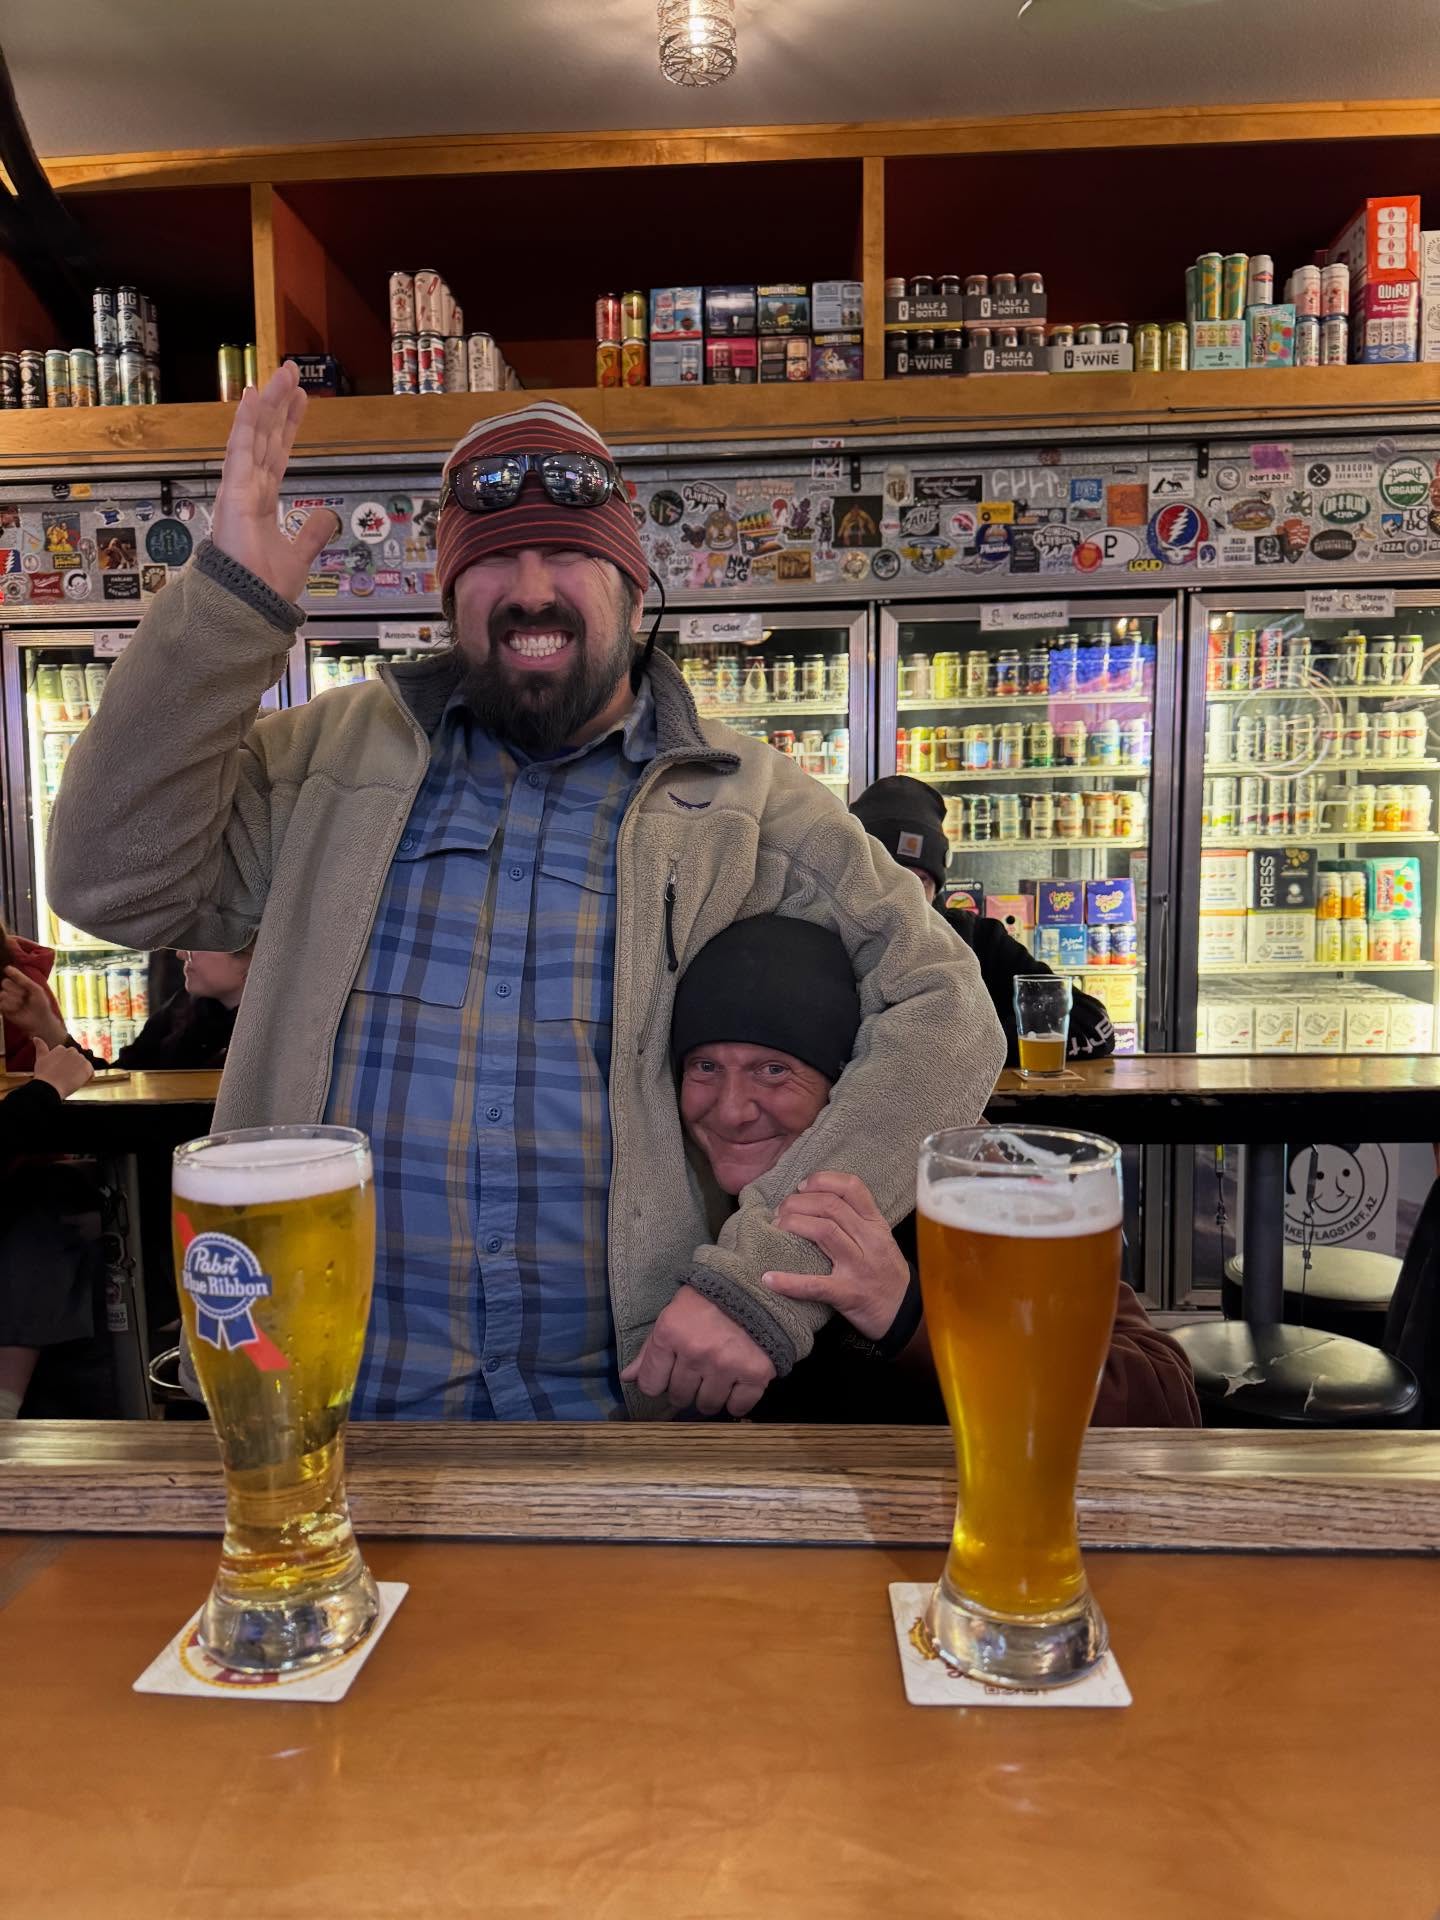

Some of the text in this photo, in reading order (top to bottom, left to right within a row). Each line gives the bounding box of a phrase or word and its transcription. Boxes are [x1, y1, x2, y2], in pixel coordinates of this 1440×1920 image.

[1377, 283, 1410, 299] QUIRK
[93, 293, 112, 308] BIG
[117, 291, 137, 306] BIG
[997, 299, 1021, 307] HALF
[915, 302, 939, 310] HALF
[997, 306, 1030, 314] BOTTLE
[915, 309, 948, 318] BOTTLE
[1001, 351, 1024, 359] HALF
[1081, 354, 1120, 366] WINE
[915, 358, 953, 370] WINE
[1001, 358, 1033, 367] BOTTLE
[1388, 485, 1424, 495] ORGANIC
[1409, 508, 1428, 520] TC
[1405, 519, 1428, 531] BC
[1129, 559, 1163, 572] LOUD
[1012, 610, 1063, 621] Kombucha
[712, 623, 740, 632] Cider
[384, 631, 416, 639] Arizona
[1259, 855, 1275, 908] PRESS
[1364, 1195, 1378, 1212] AZ
[192, 1246, 240, 1275] Pabst
[208, 1276, 269, 1297] Ribbon
